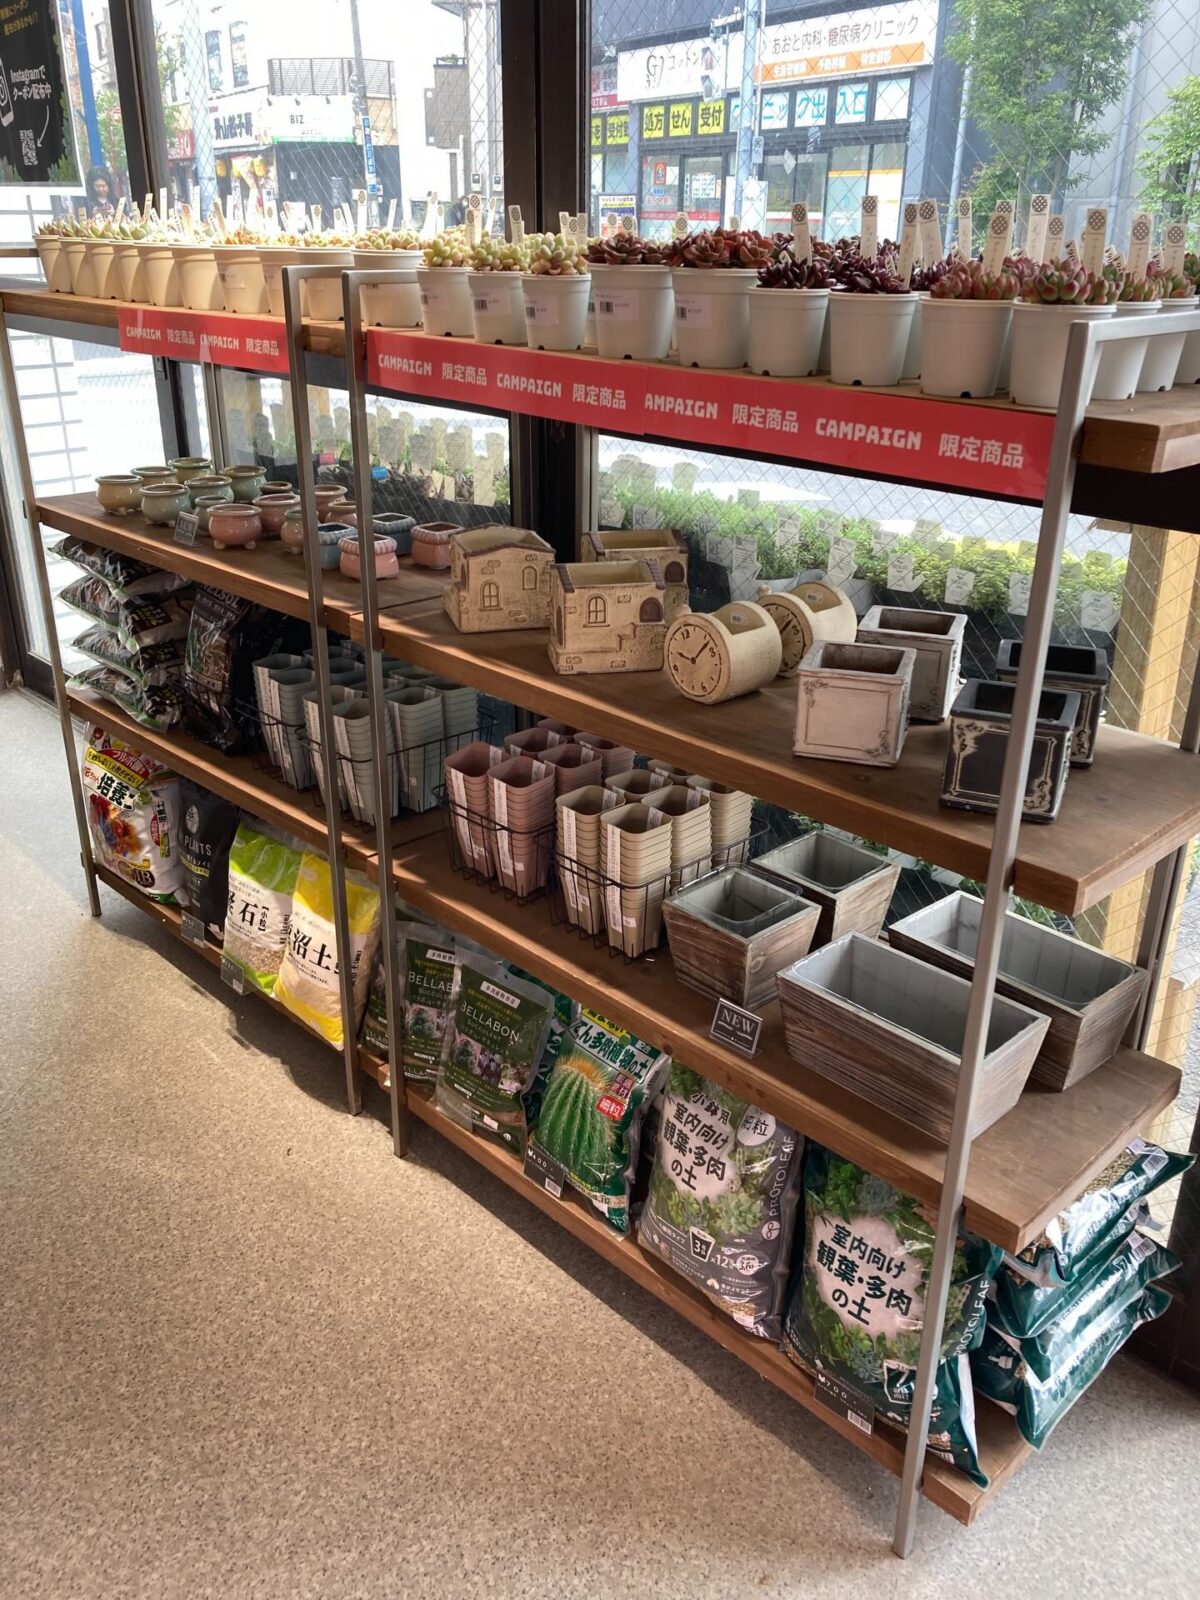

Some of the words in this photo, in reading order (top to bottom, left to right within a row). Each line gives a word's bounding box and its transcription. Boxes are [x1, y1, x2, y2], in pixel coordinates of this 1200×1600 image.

[10, 64, 46, 84] Instagramで
[289, 114, 304, 124] BIZ
[126, 326, 161, 342] CAMPAIGN
[167, 328, 196, 346] 限定商品
[245, 337, 279, 357] 限定商品
[378, 353, 432, 377] CAMPAIGN
[441, 362, 487, 387] 限定商品
[496, 372, 562, 398] CAMPAIGN
[572, 383, 626, 411] 限定商品
[644, 392, 719, 421] AMPAIGN
[732, 403, 799, 434] 限定商品
[815, 417, 922, 451] CAMPAIGN
[938, 432, 1024, 470] 限定商品
[680, 628, 691, 642] 12
[707, 647, 717, 658] 3
[96, 772, 135, 811] 培養
[288, 923, 333, 971] 沼土
[460, 1000, 520, 1042] BELLABON
[721, 1007, 756, 1034] NEW
[673, 1102, 730, 1150] 室内向け
[691, 1091, 732, 1126] 小鉢用
[663, 1118, 727, 1182] 観葉・多肉
[671, 1159, 698, 1192] の土
[769, 1135, 796, 1217] PROTOLEAF
[830, 1223, 907, 1280] 室内向け
[816, 1239, 913, 1317] 観葉・多肉
[831, 1288, 872, 1326] の土
